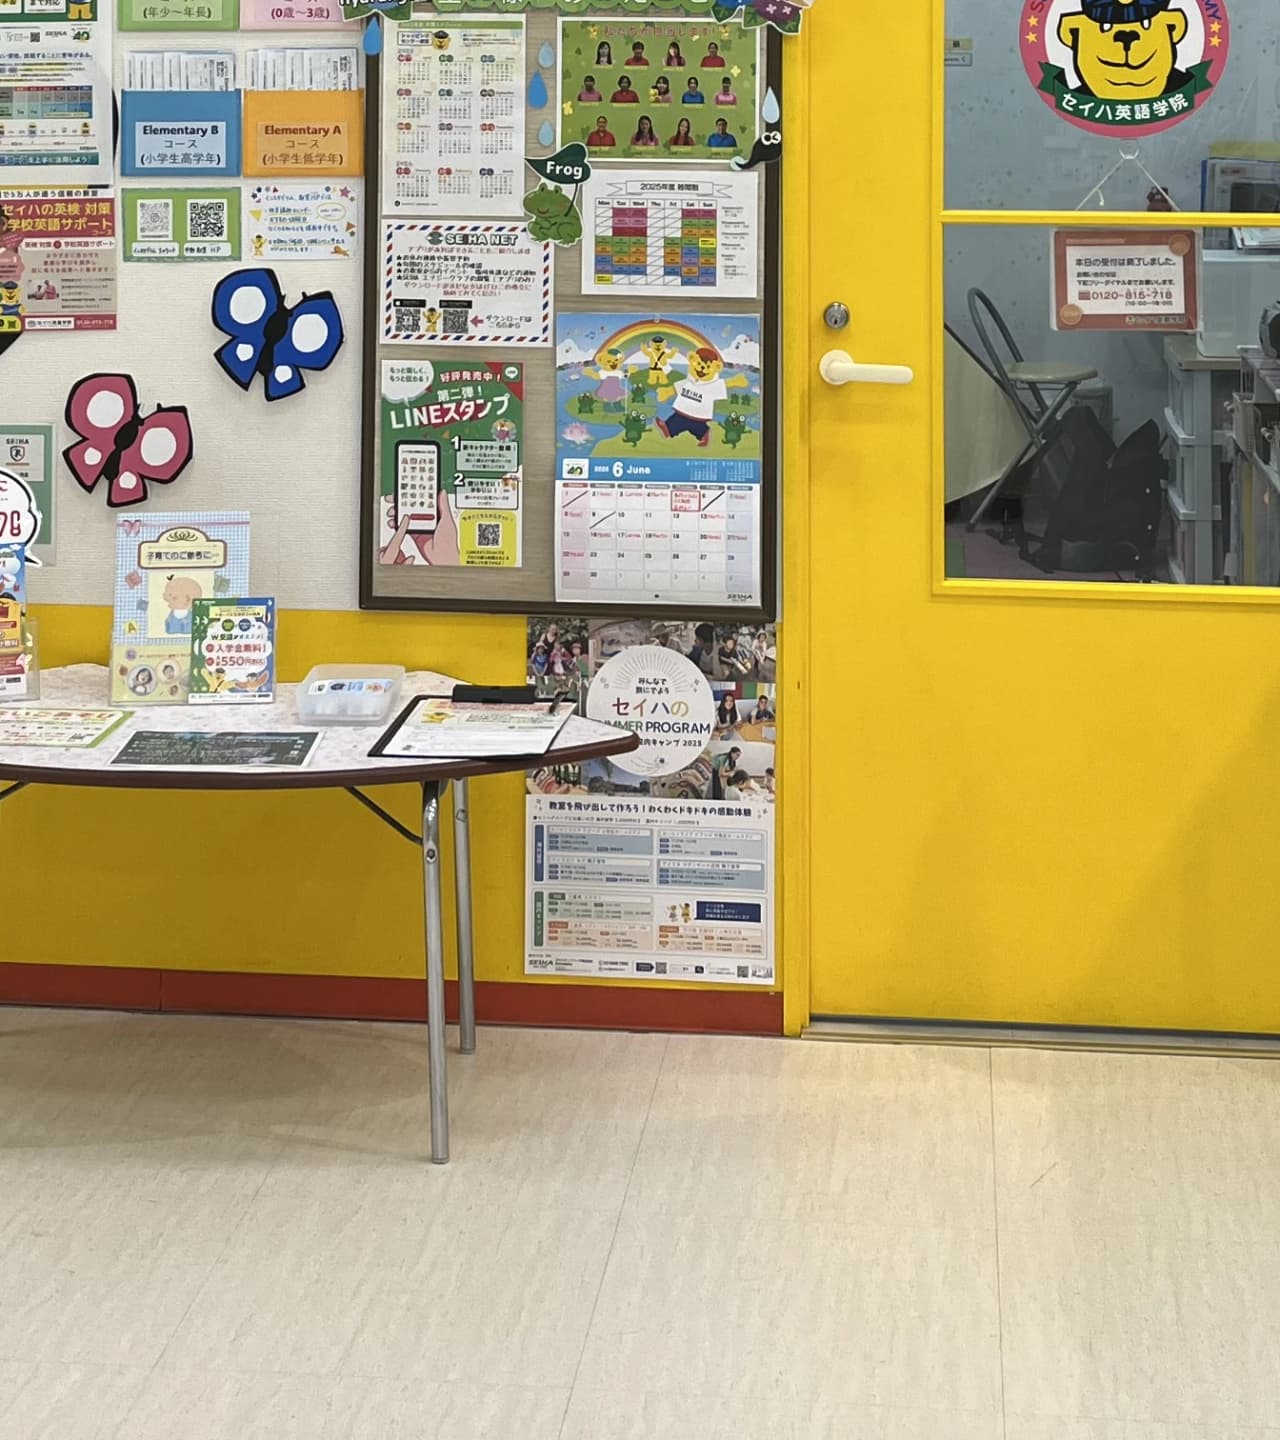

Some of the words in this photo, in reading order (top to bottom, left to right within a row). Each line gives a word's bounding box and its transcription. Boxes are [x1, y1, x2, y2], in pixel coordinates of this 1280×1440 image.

[1061, 93, 1190, 121] セイハ英語学院
[142, 125, 209, 137] Elementary
[210, 125, 220, 136] B
[264, 125, 330, 137] Elementary
[332, 125, 342, 136] A
[163, 139, 198, 149] コース
[285, 139, 320, 149] コース
[546, 161, 583, 179] Frog
[490, 233, 519, 246] NET
[389, 393, 510, 430] LINEスタンプ
[612, 461, 624, 477] 6
[626, 466, 651, 475] June
[454, 472, 464, 486] 2
[612, 697, 689, 718] セイハの
[645, 721, 711, 734] PROGRAM
